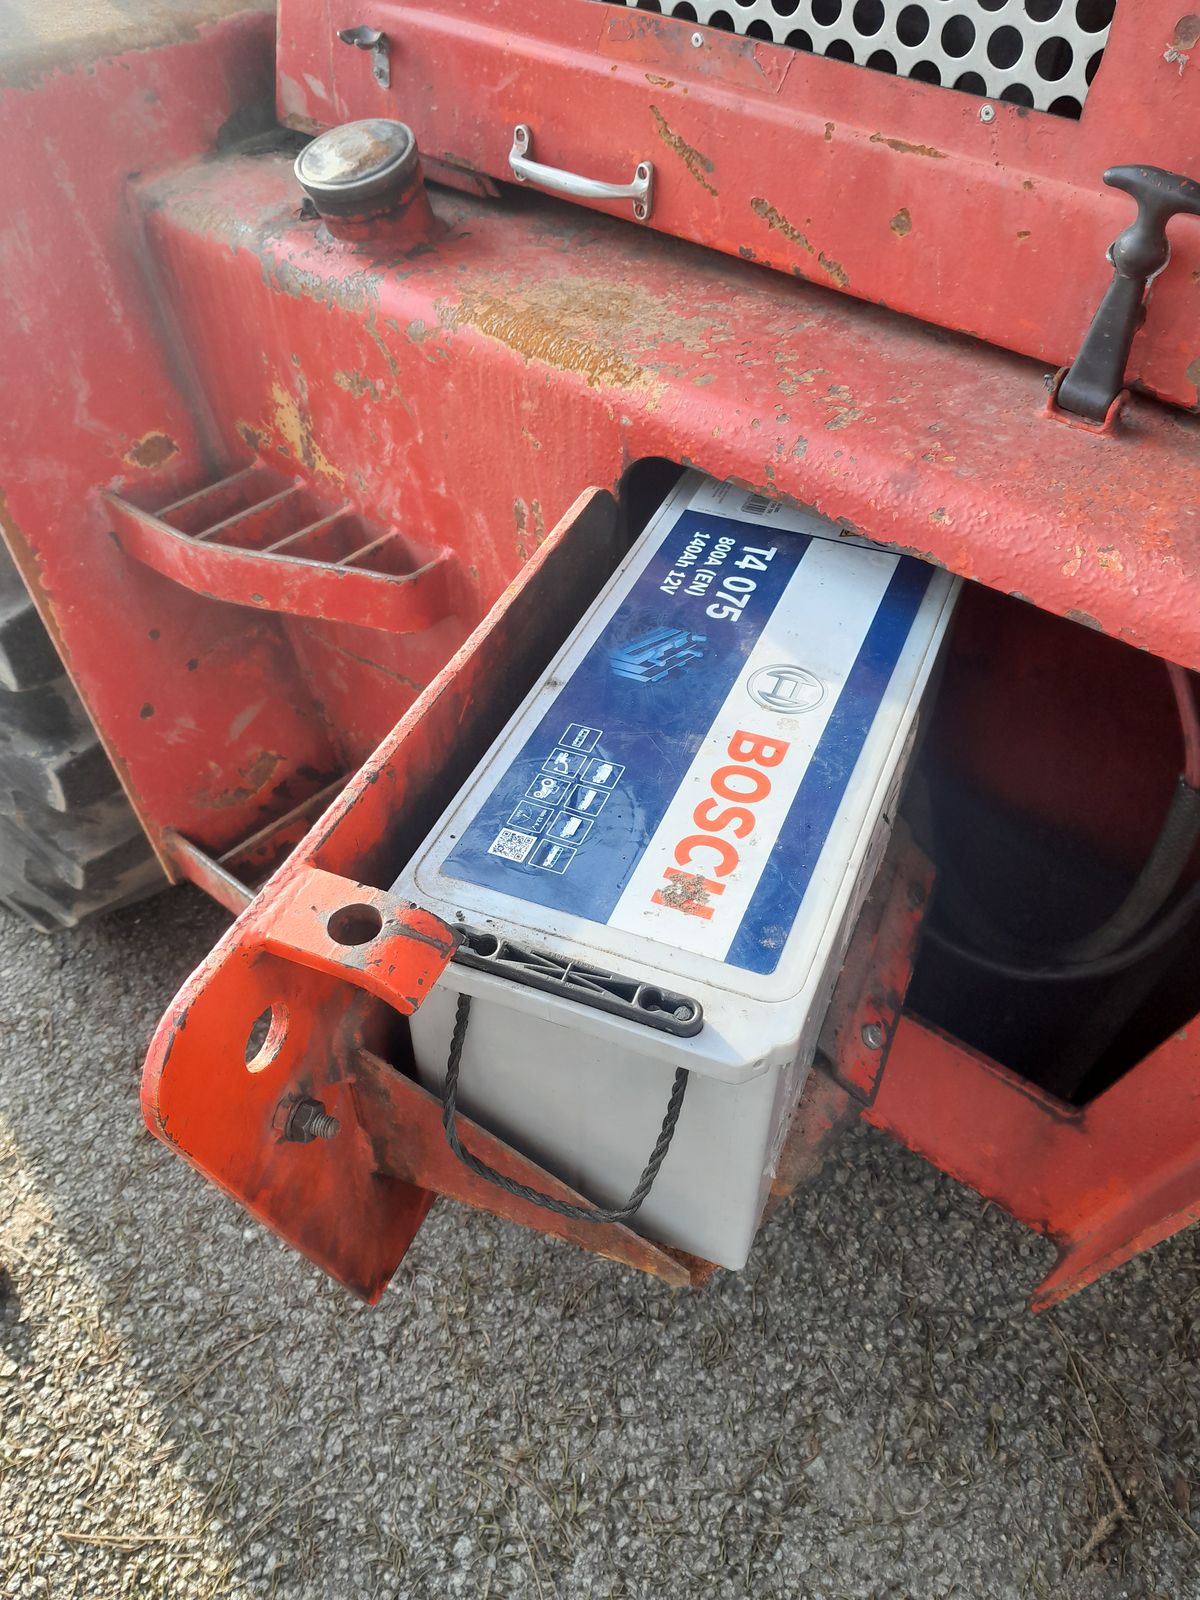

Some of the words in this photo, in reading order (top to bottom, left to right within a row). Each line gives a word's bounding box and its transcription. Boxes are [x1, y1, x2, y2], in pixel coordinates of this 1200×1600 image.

[675, 532, 711, 567] 140Ah
[704, 537, 735, 565] 800A
[734, 546, 777, 571] T4
[660, 570, 686, 595] 12V
[684, 569, 716, 596] (EN)
[706, 576, 757, 622] 075
[650, 729, 791, 920] BOSCH
